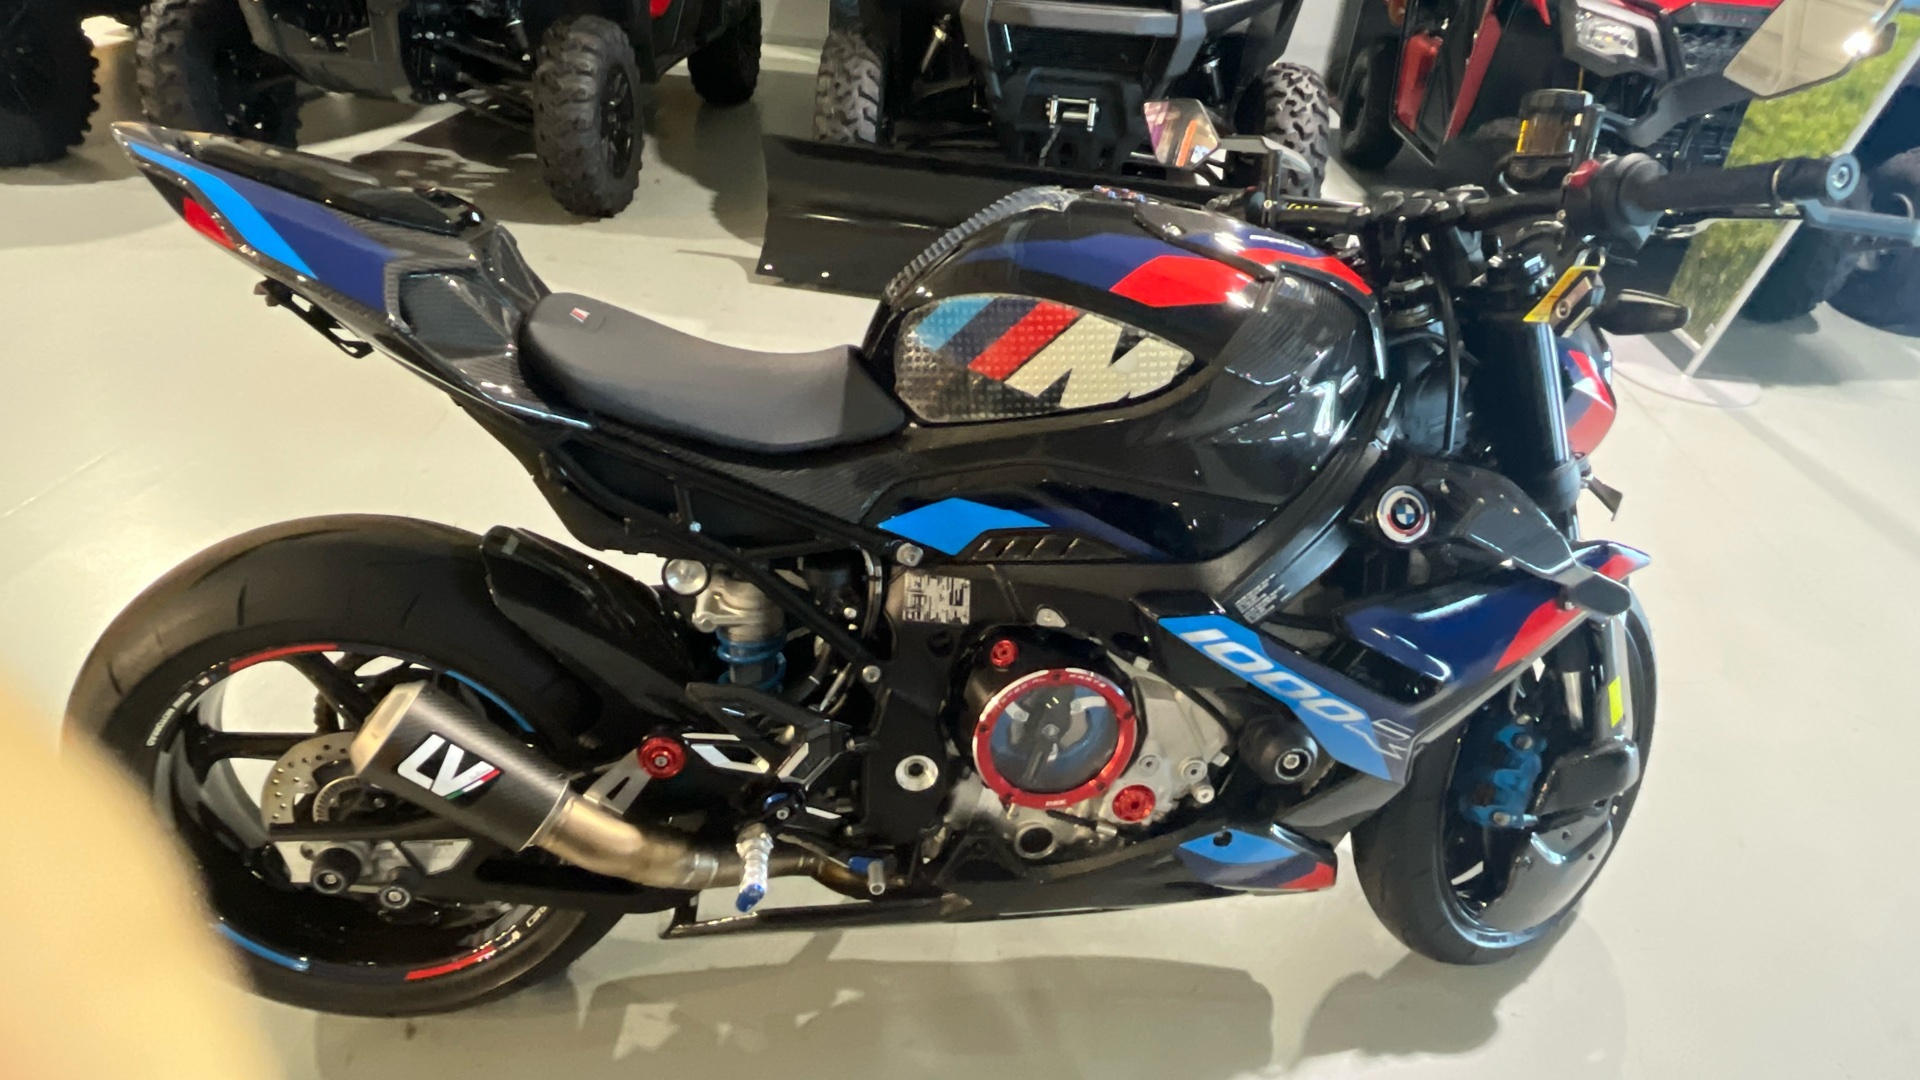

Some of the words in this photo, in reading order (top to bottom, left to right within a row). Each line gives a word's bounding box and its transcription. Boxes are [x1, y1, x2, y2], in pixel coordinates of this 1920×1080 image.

[1004, 313, 1184, 409] M
[1180, 628, 1367, 722] 1000
[397, 734, 496, 797] LV
